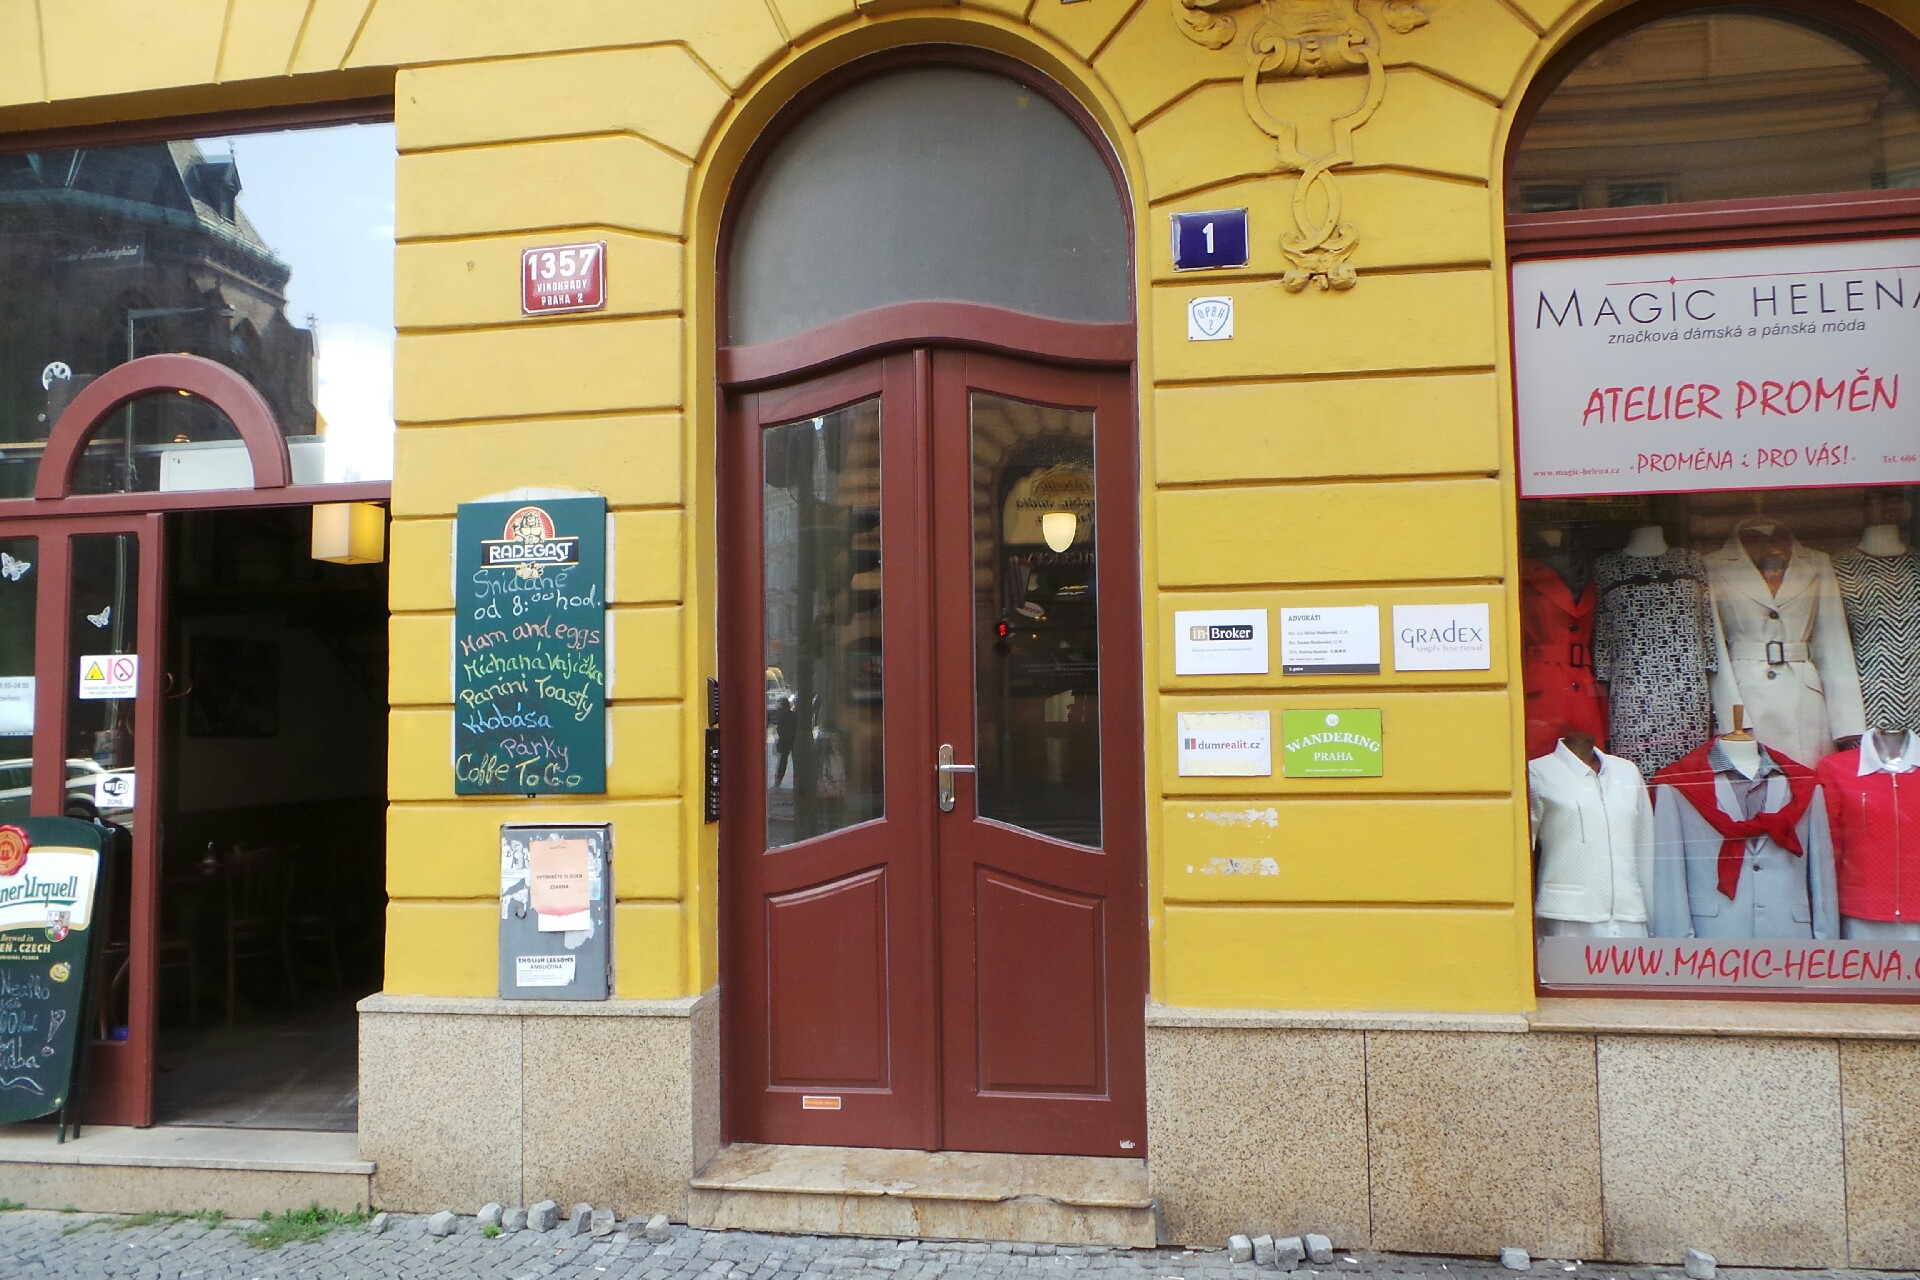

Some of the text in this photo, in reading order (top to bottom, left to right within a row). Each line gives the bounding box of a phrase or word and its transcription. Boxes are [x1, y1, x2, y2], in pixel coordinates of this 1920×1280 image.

[1202, 222, 1214, 253] 1
[528, 248, 596, 281] 1357
[536, 280, 587, 292] VINOHRADY
[541, 293, 584, 306] PRAHA 2
[1535, 276, 1920, 330] MAGIC HELEN
[1197, 306, 1226, 319] OPBH
[1208, 319, 1214, 331] 2
[1608, 317, 1866, 345] značková dámská a pánská móda
[1582, 367, 1899, 427] ATELIER PROMĚN
[1533, 466, 1620, 478] www.magic-helena.cz
[1636, 446, 1733, 474] PROMĚNA
[1757, 447, 1797, 470] PRO
[1805, 442, 1849, 467] VÁS!
[489, 542, 573, 563] RADEGAST
[474, 598, 502, 620] od
[1288, 613, 1321, 622] ADVOKÁTI
[460, 615, 601, 656] Ham and eggs
[459, 673, 594, 722] Panini Toasty
[500, 735, 569, 773] Párky
[1197, 738, 1261, 750] dumrealit.cz
[1286, 732, 1380, 754] WANDERING
[1313, 752, 1354, 761] PRAHA
[456, 753, 510, 785] Coffe
[515, 756, 540, 785] To
[106, 798, 124, 806] ZONE
[24, 873, 79, 908] Urquell
[19, 943, 51, 953] CZECH
[27, 934, 34, 942] in
